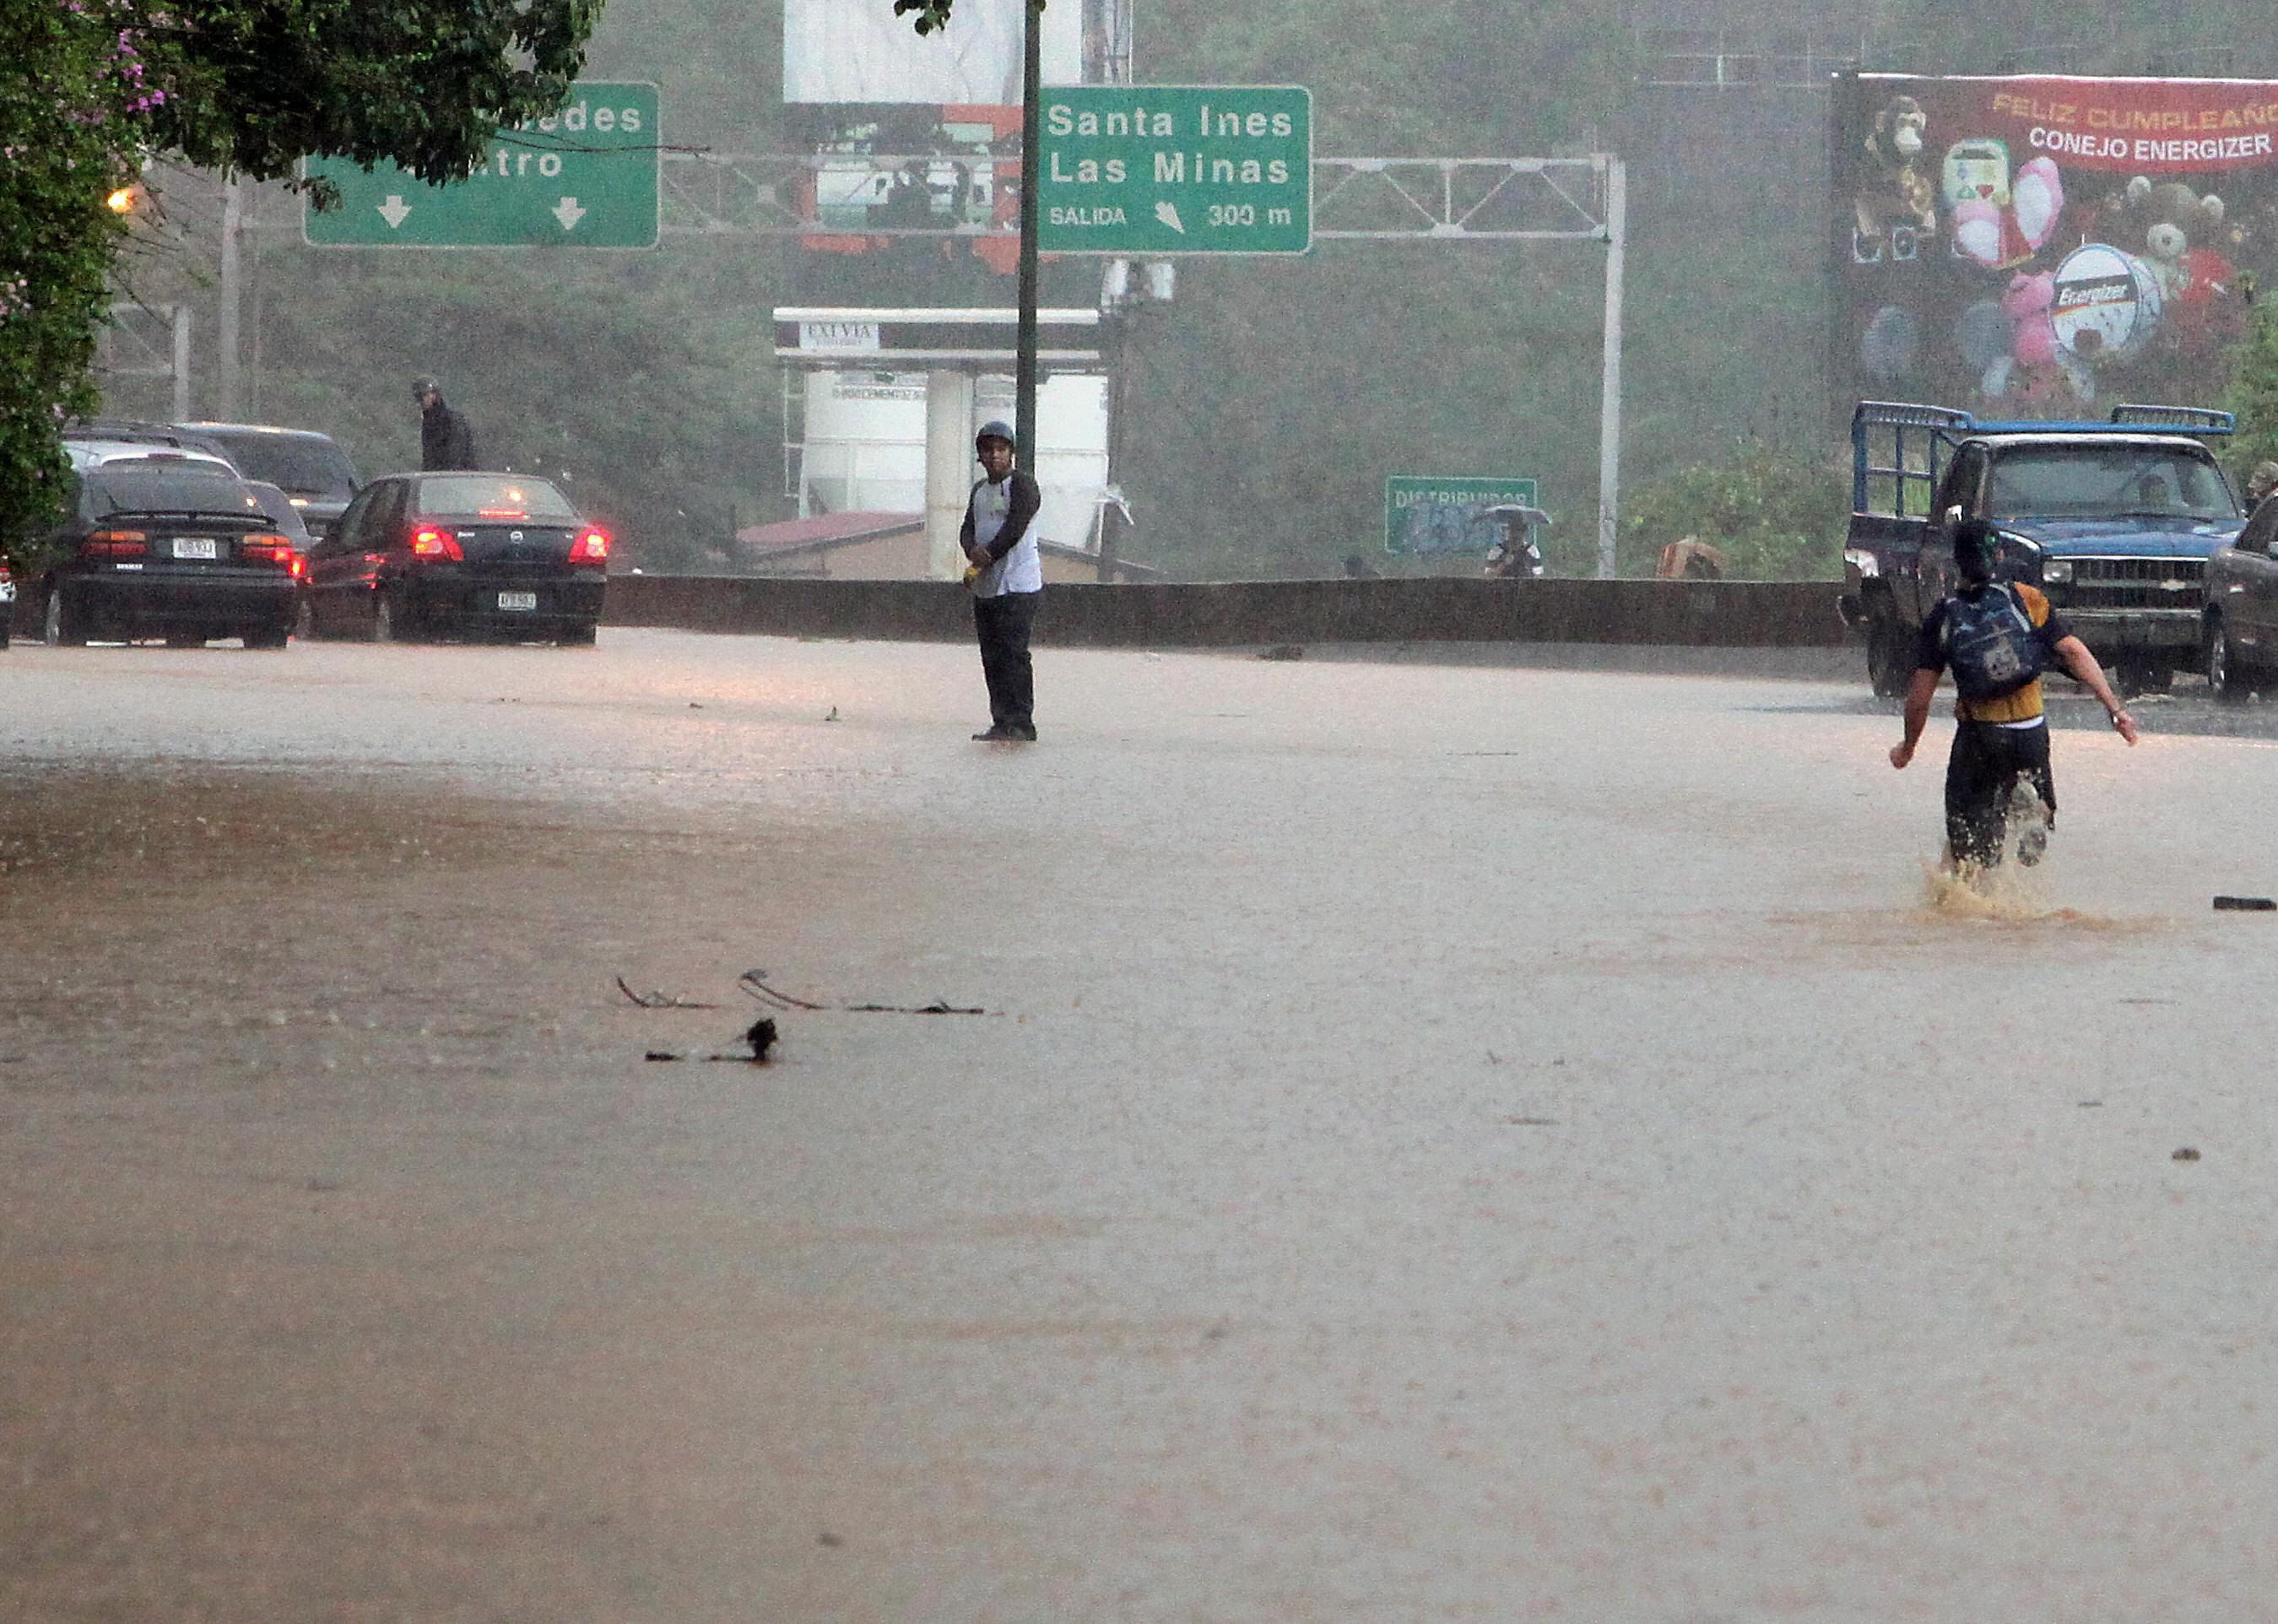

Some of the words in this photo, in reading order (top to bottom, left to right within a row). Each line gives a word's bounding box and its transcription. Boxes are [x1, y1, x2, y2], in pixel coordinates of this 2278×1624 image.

[1047, 104, 1174, 137] Santa
[1200, 103, 1292, 137] Ines
[1993, 94, 2078, 123] FELIZ
[2030, 127, 2129, 159] CONEJO
[2134, 133, 2272, 161] ENERGIZER
[1051, 152, 1128, 184] Las
[1153, 152, 1289, 184] Minas
[1050, 207, 1127, 225] SALIDA
[1209, 205, 1256, 226] 300
[1268, 208, 1291, 225] m
[2059, 284, 2128, 306] Energizer
